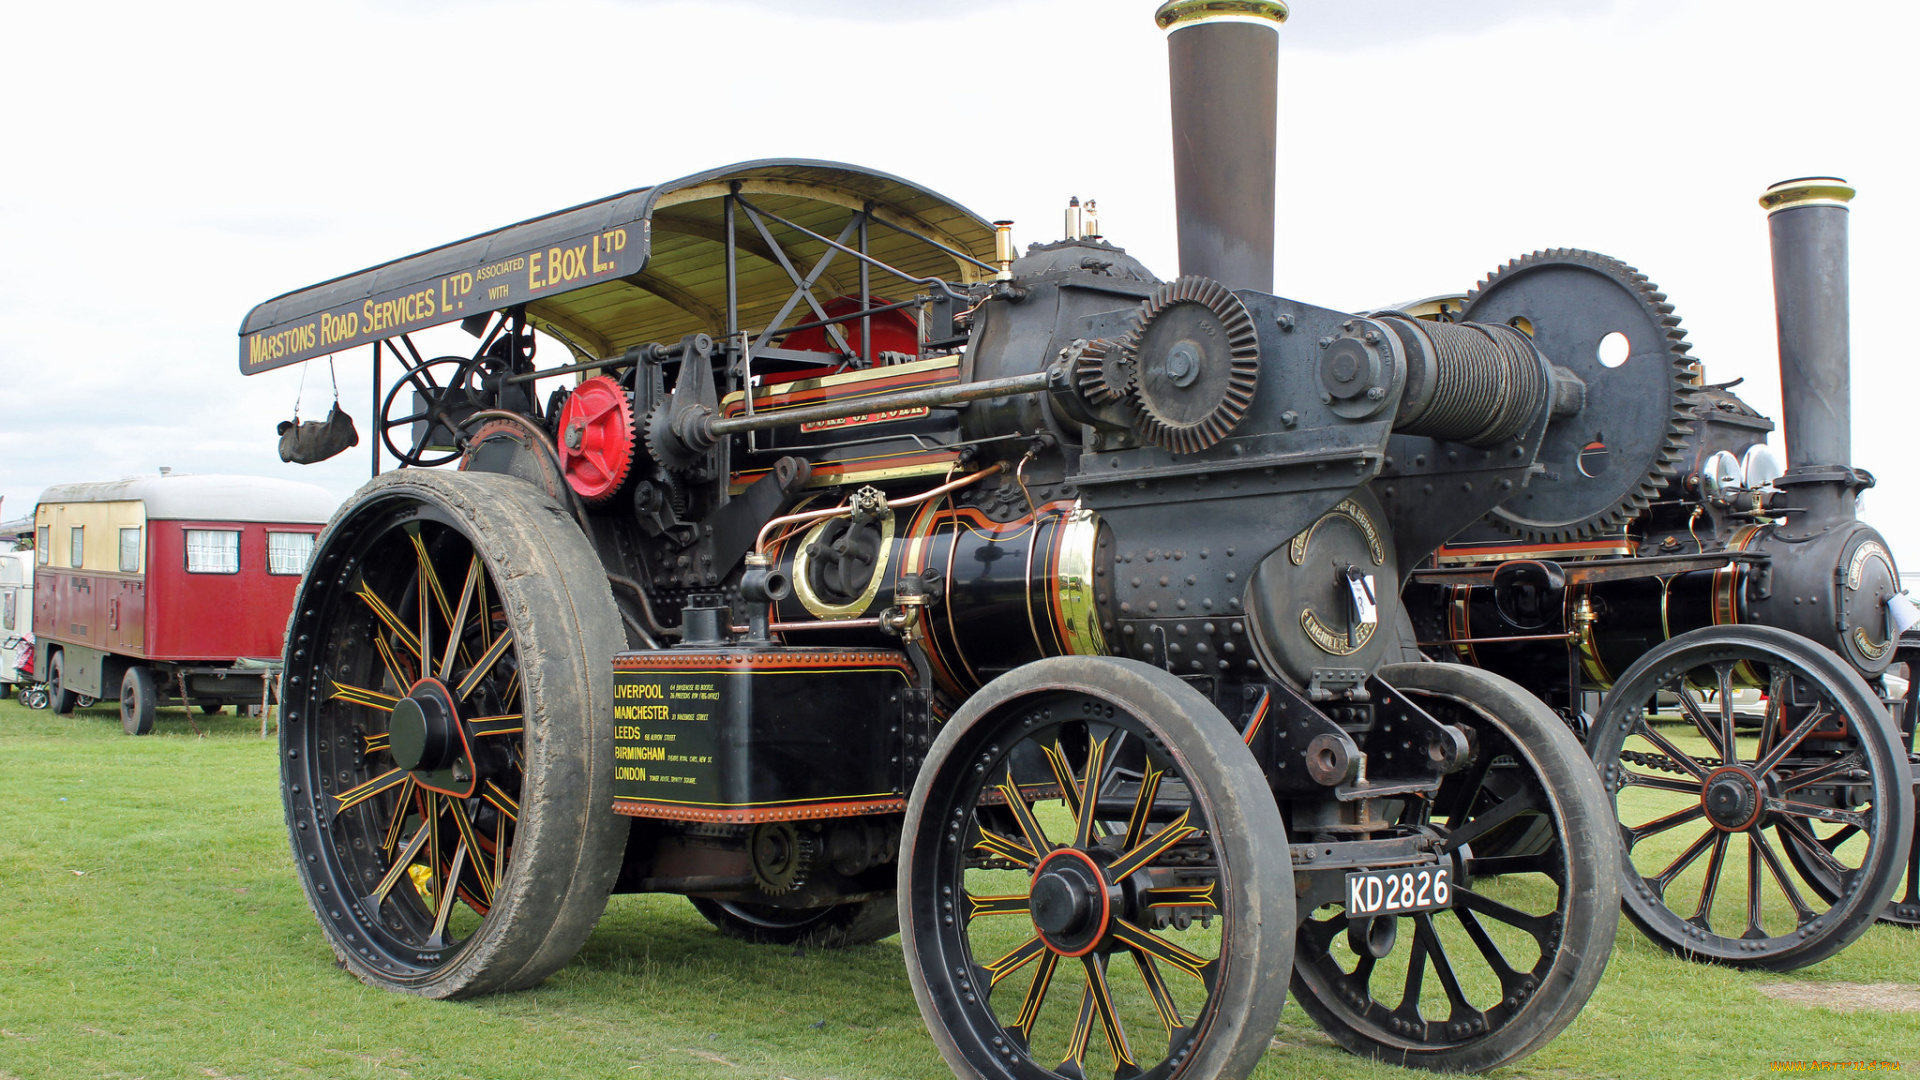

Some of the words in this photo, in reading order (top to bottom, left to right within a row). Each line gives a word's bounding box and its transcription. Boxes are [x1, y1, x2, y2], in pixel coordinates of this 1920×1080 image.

[476, 257, 525, 282] ASSOCIATED
[488, 284, 509, 301] WITH
[250, 322, 316, 365] MARSTONS
[321, 311, 359, 347] ROAD
[362, 288, 436, 335] SERVICES
[614, 684, 664, 699] LIVERPOOL
[614, 705, 670, 720] MANCHESTER
[614, 726, 641, 740] LEEDS
[614, 746, 666, 761] BIRMINGHAM
[614, 766, 646, 781] LONDON
[1351, 869, 1449, 914] KD2826
